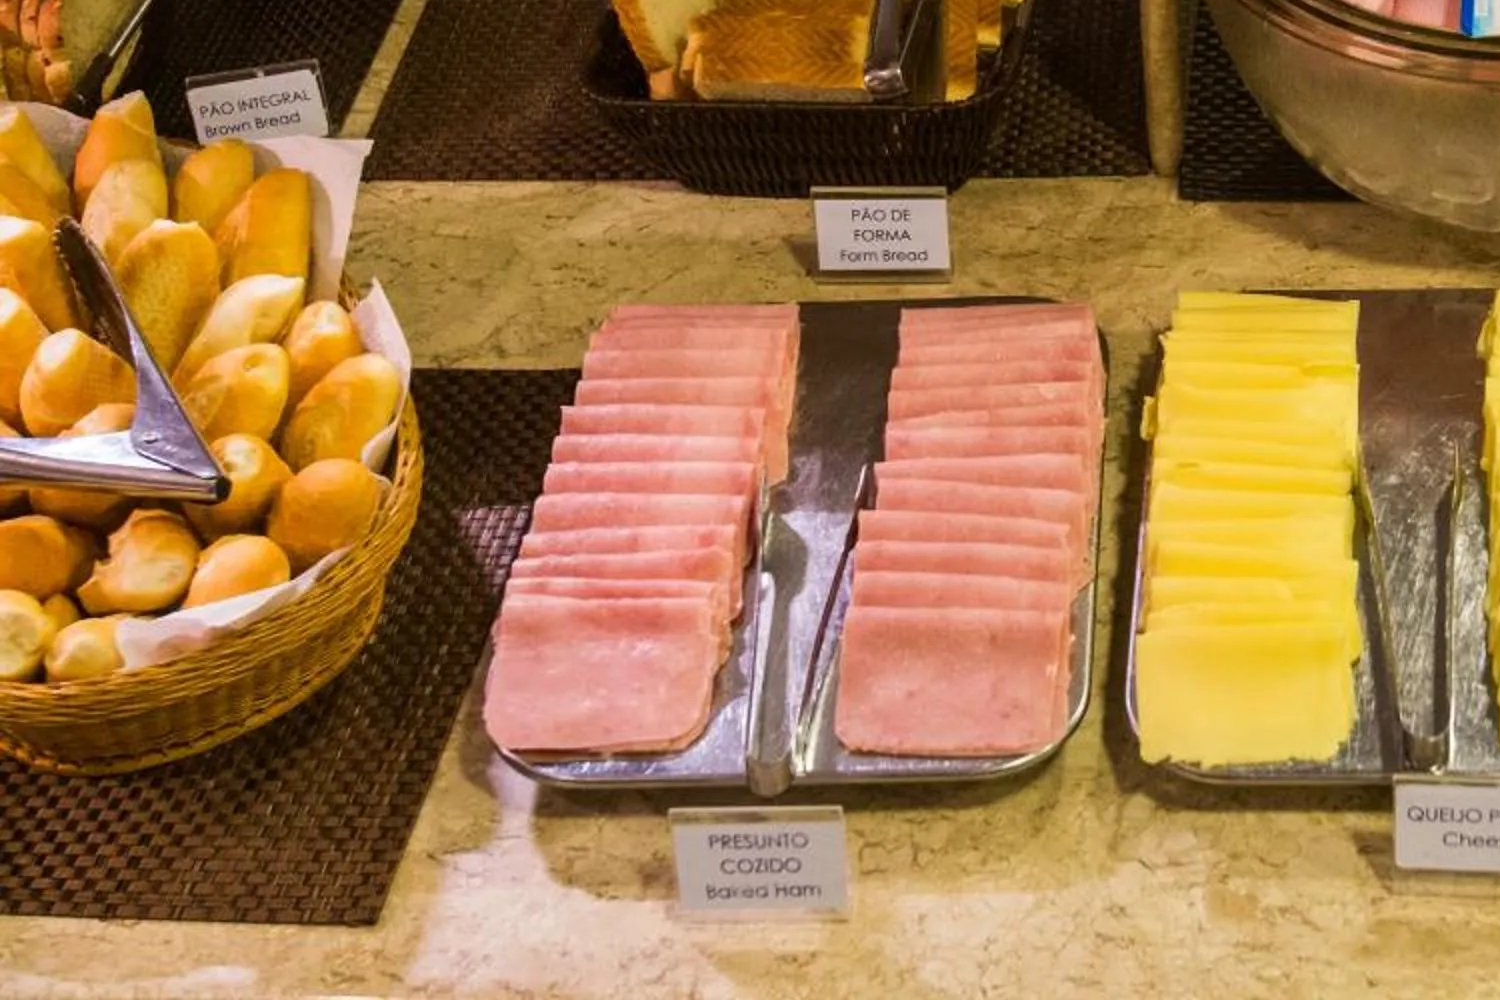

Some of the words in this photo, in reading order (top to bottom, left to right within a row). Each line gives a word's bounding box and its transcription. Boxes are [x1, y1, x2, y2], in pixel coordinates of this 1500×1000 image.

[199, 100, 235, 119] PÃO
[237, 89, 312, 112] INTEGRAL
[204, 122, 251, 138] Brown
[254, 111, 301, 130] Bread
[851, 207, 886, 222] PÃO
[891, 209, 912, 222] DE
[853, 229, 912, 242] FORMA
[882, 249, 929, 262] Bread
[1406, 805, 1483, 824] QUEIJO
[708, 832, 810, 851] PRESUNTO
[719, 857, 803, 875] COZIDO
[774, 883, 822, 899] Ham
